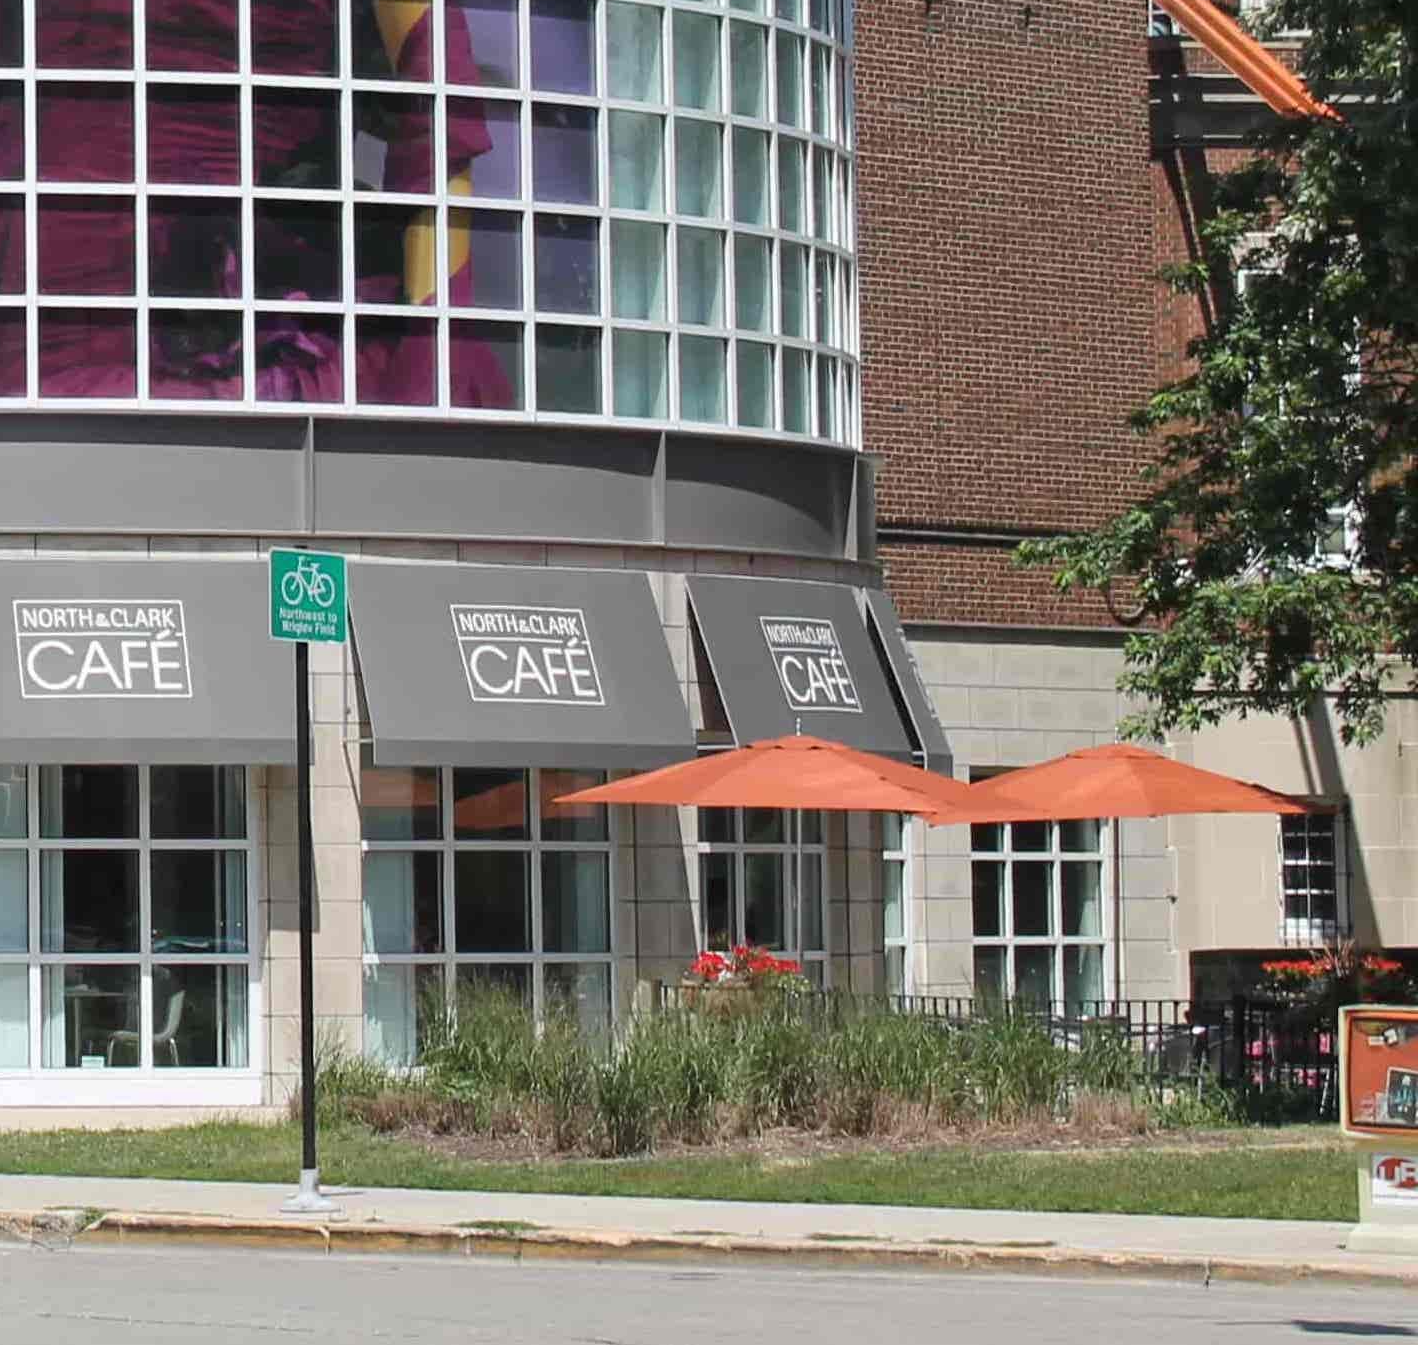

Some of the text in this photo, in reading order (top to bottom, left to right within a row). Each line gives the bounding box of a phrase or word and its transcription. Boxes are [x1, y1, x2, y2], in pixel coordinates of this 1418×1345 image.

[315, 622, 336, 635] Field
[328, 612, 338, 623] to
[27, 629, 183, 690] CAFÉ
[470, 637, 597, 697] CAFÉ
[781, 648, 857, 705] CAFÉ
